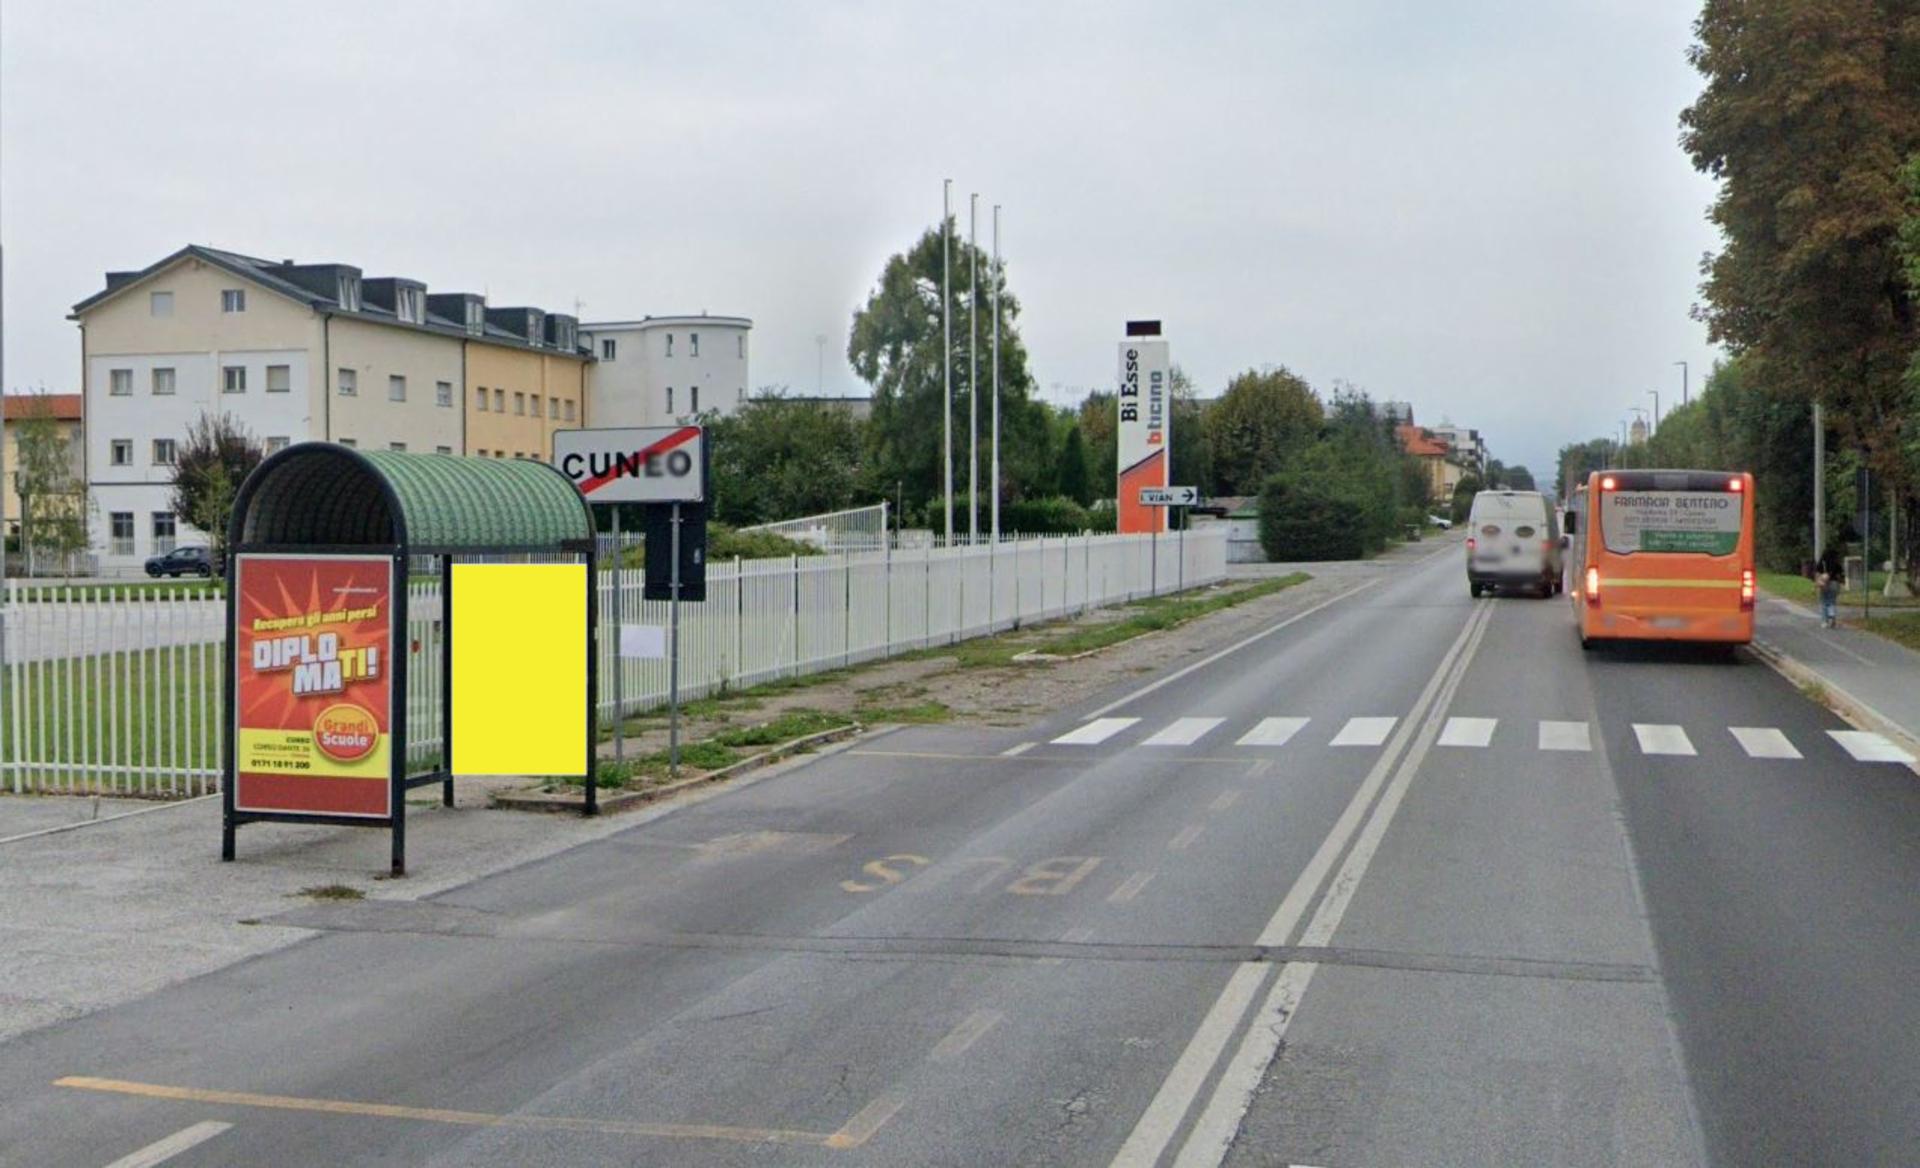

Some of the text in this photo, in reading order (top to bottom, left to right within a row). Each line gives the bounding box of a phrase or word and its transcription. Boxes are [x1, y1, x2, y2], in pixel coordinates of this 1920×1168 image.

[1121, 348, 1138, 422] Bi Esse
[1147, 371, 1163, 445] bticino
[562, 450, 692, 480] CUNEO
[253, 632, 338, 670] DIPLO
[322, 732, 368, 746] Scuole
[323, 719, 369, 733] Grandi
